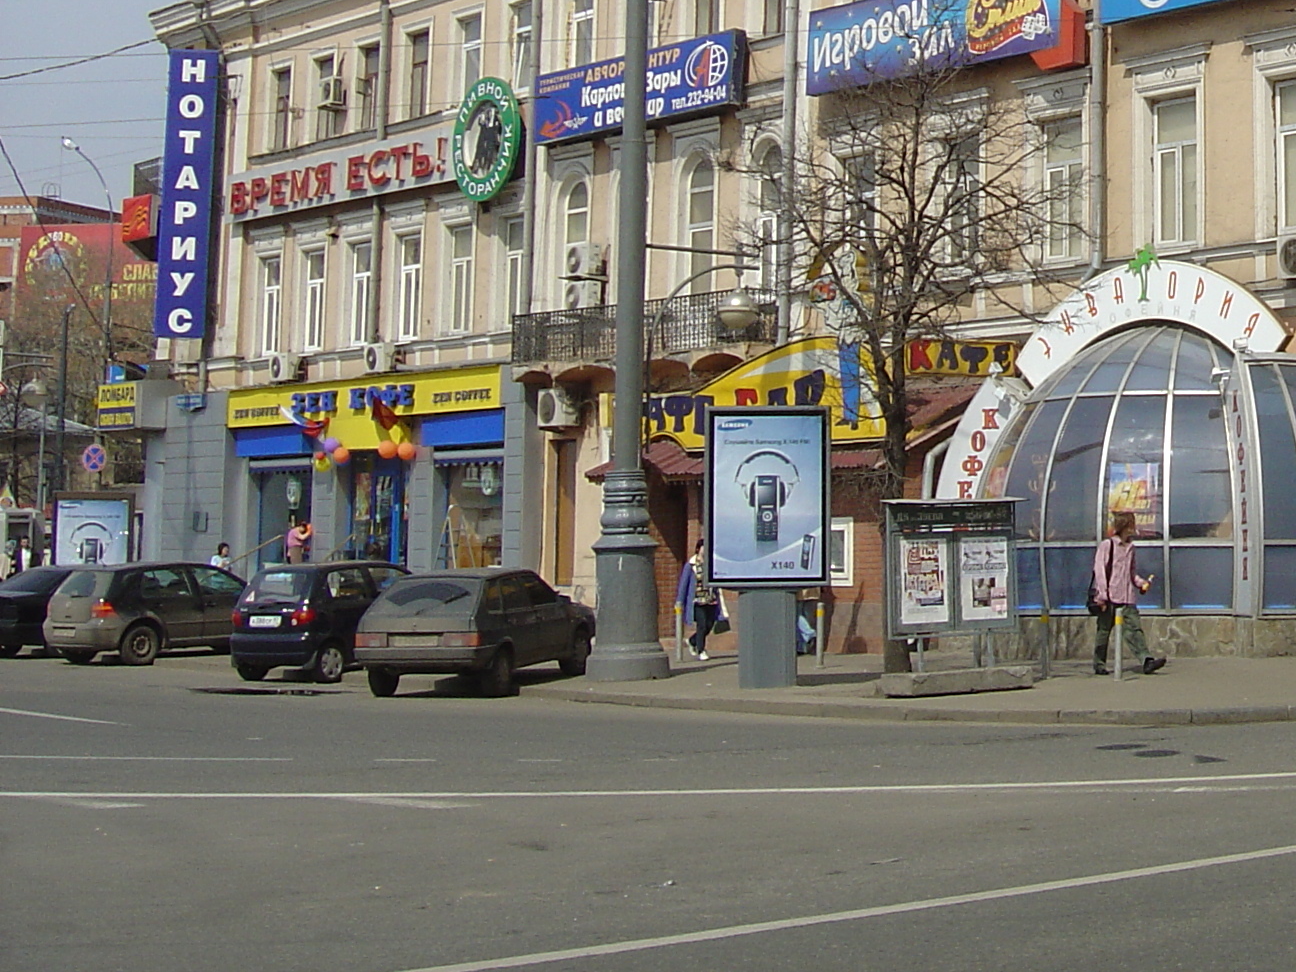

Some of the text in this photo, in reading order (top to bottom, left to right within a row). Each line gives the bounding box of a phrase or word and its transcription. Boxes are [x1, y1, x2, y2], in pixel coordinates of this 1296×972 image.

[648, 48, 681, 68] НТУР
[229, 136, 448, 215] ВРЕМЯ ЕСТЬ!
[168, 58, 206, 334] НОТАРИУС
[290, 384, 415, 414] ЗЕН КОФЕ
[771, 561, 795, 570] X140
